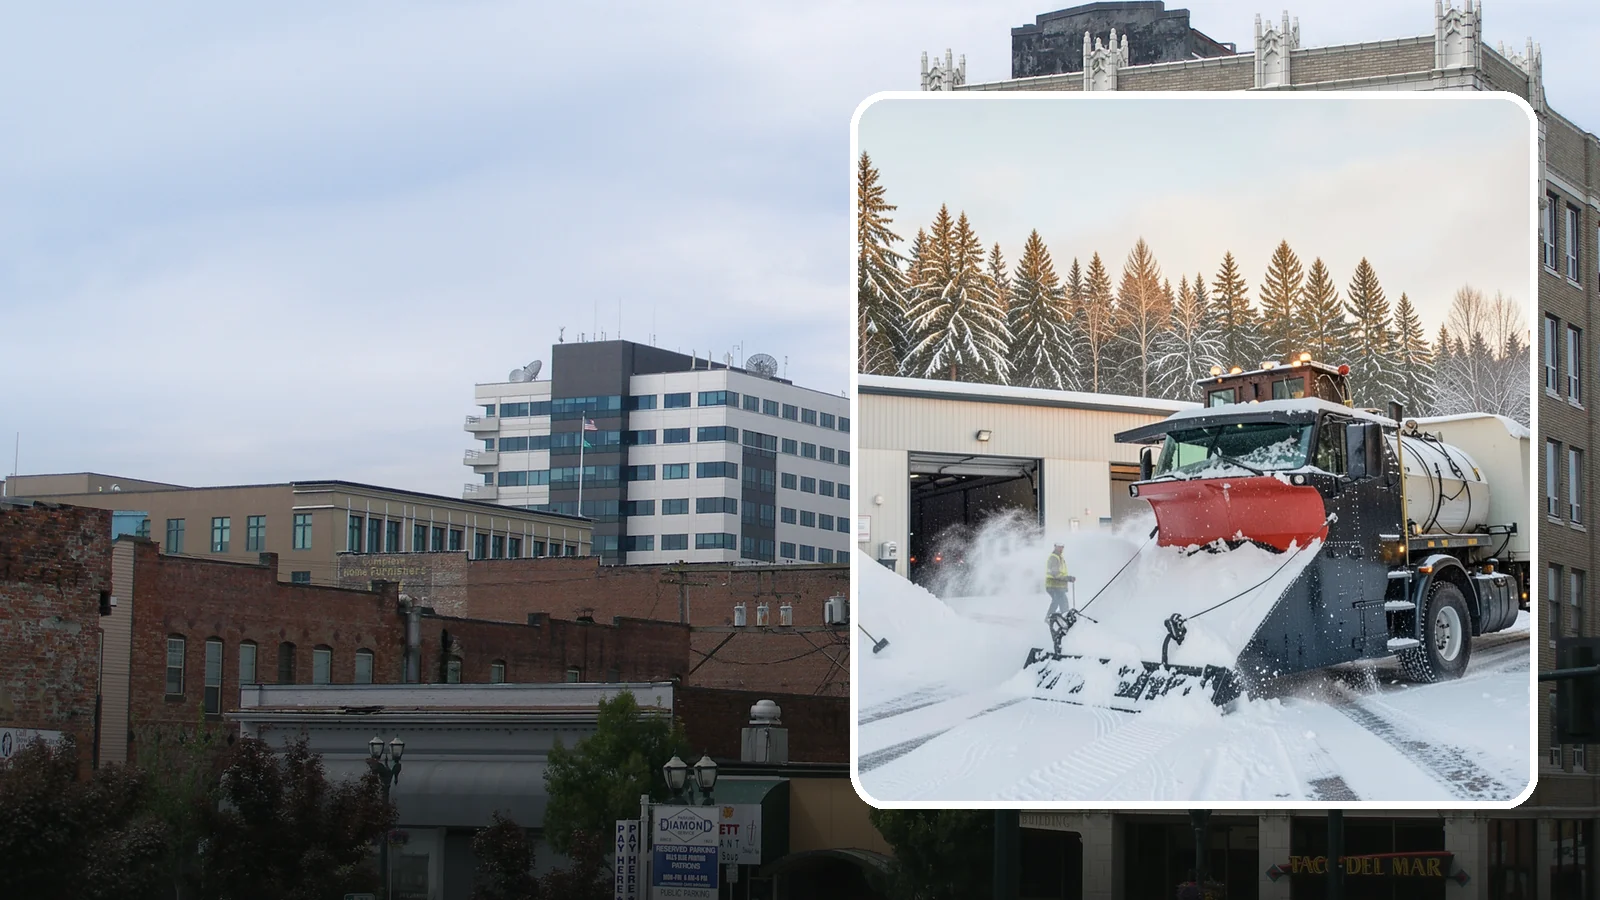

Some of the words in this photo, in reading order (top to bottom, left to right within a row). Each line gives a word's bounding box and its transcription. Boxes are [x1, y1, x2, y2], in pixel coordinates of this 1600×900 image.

[370, 566, 426, 577] Furnishers
[660, 818, 713, 832] DIAMOND
[1022, 815, 1070, 828] BUILDING
[617, 824, 625, 853] PAY
[628, 824, 637, 853] PAY
[655, 845, 688, 853] RESERVED
[689, 846, 716, 854] PARKING
[721, 851, 739, 862] Soup
[671, 861, 701, 870] PATRONS
[1289, 855, 1329, 874] TAC
[1344, 856, 1385, 876] DEL
[1392, 857, 1442, 877] MAR
[616, 856, 625, 894] HERE
[627, 855, 636, 893] HERE
[660, 888, 682, 897] PUBLIC
[683, 889, 710, 898] PARKING
